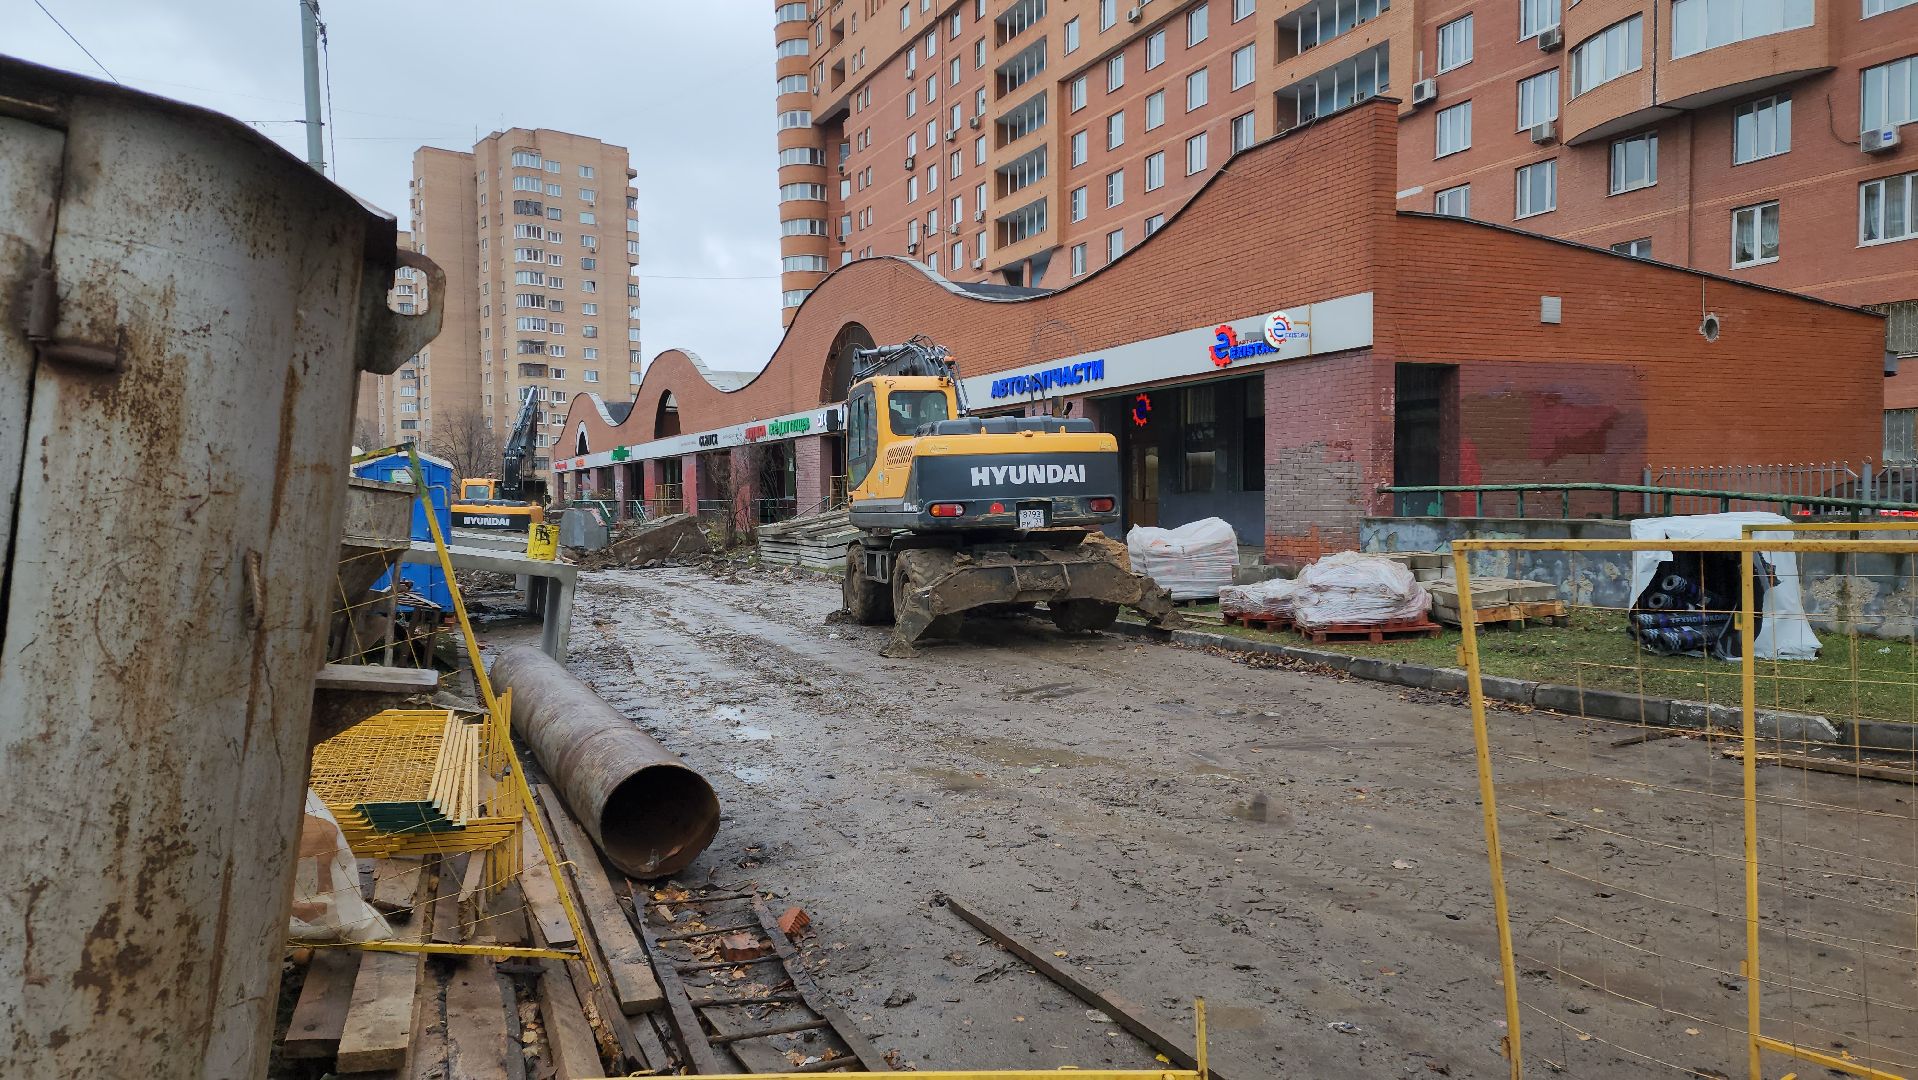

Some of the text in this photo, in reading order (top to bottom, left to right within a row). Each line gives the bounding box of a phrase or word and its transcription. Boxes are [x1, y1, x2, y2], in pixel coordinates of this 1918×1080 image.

[1229, 341, 1279, 360] EXIST.R
[991, 359, 1105, 399] АВТОЗАПЧАСТИ
[970, 464, 1086, 487] HYUNDAI
[463, 516, 510, 527] HYUNDAI
